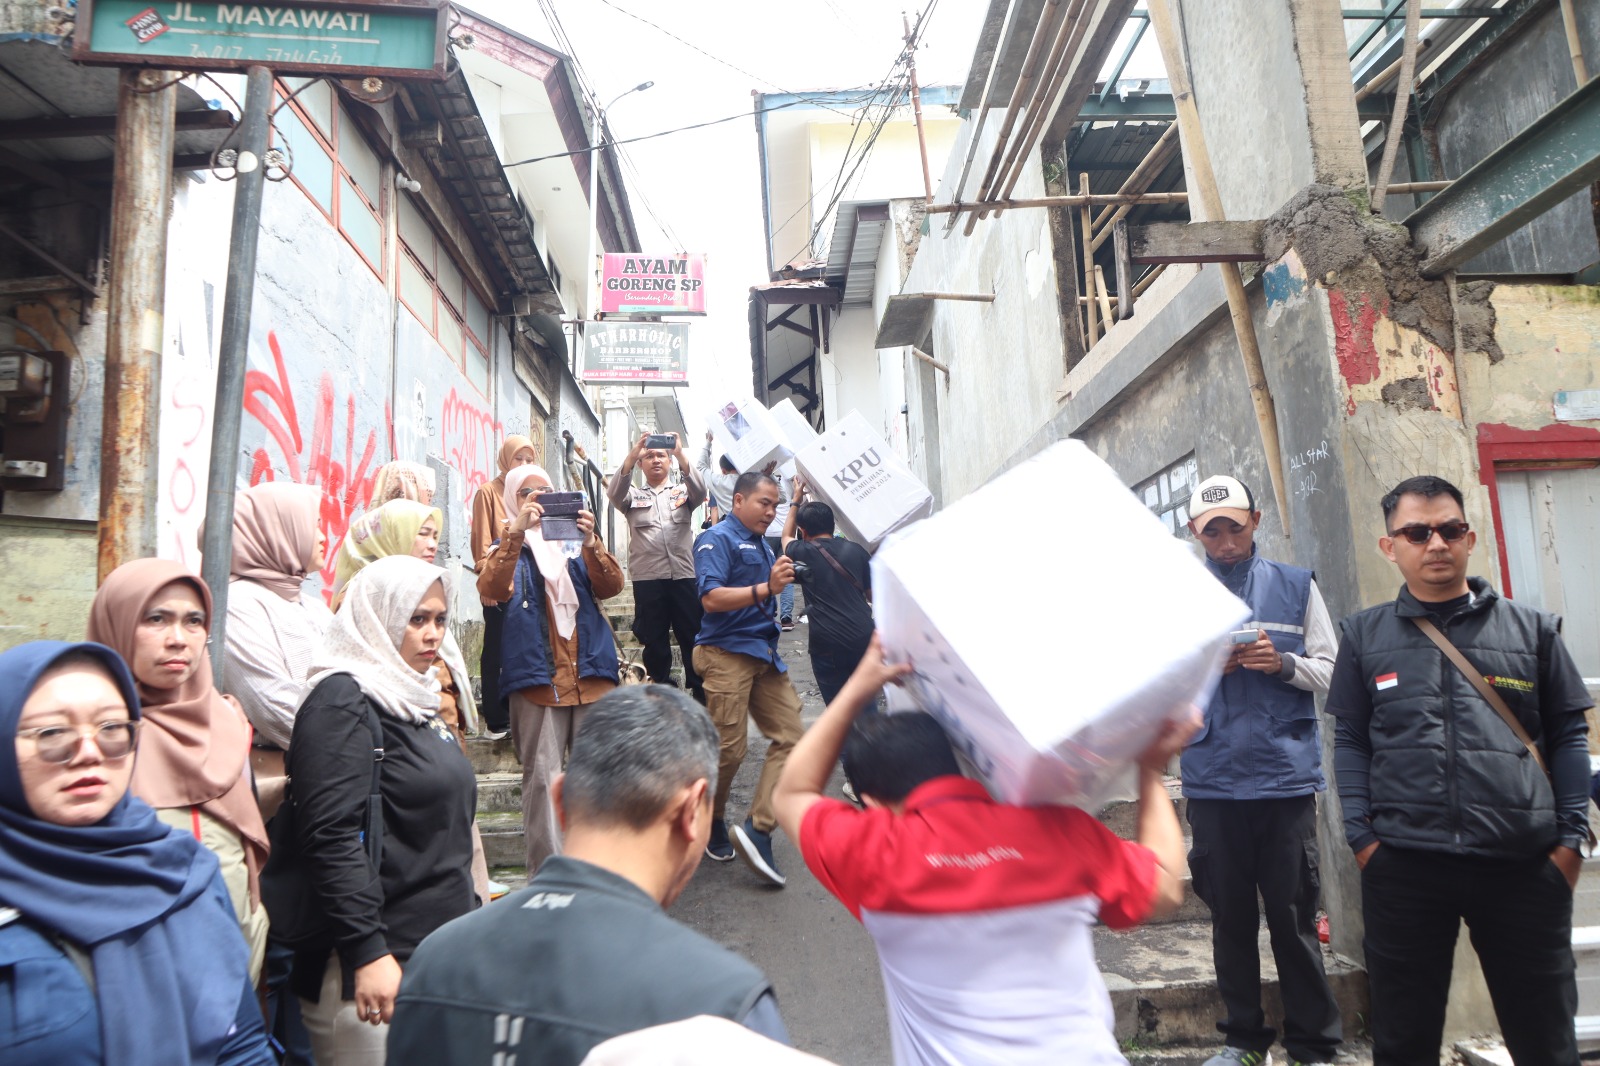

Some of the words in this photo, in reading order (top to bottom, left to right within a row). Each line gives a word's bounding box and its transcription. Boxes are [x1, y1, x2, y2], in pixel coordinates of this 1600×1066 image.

[167, 2, 206, 22] JL.
[217, 4, 370, 32] MAYAWATI
[622, 258, 688, 275] AYAM
[607, 278, 676, 291] GORENG
[681, 279, 702, 292] SP
[600, 347, 672, 355] BARBERSHOP
[832, 447, 882, 492] KPU
[850, 467, 885, 496] PEMILIHAN
[856, 484, 877, 502] TAHUN
[875, 472, 892, 491] 2024
[1203, 489, 1228, 501] EIGER
